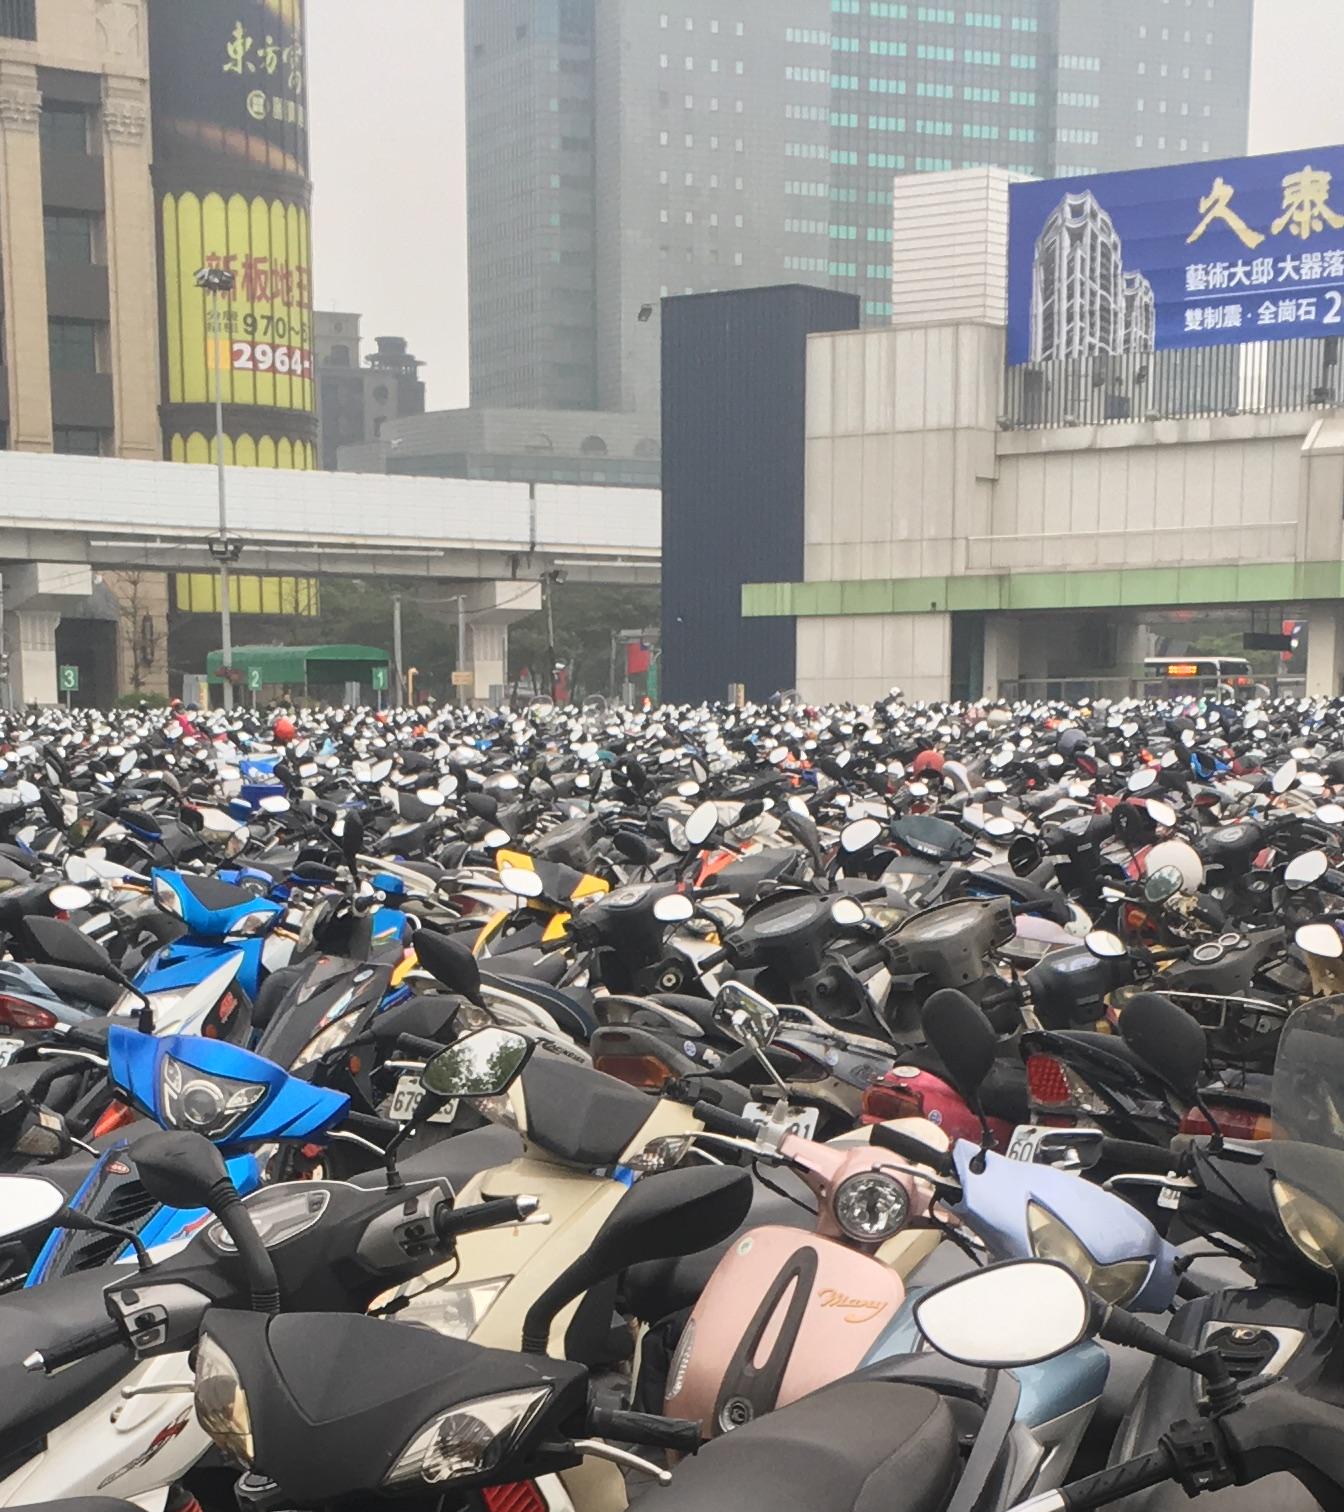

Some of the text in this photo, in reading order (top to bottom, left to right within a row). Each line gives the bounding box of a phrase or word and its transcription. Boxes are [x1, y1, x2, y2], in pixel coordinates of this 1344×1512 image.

[232, 341, 314, 377] 2964-
[64, 670, 75, 687] 3
[251, 671, 260, 687] 2
